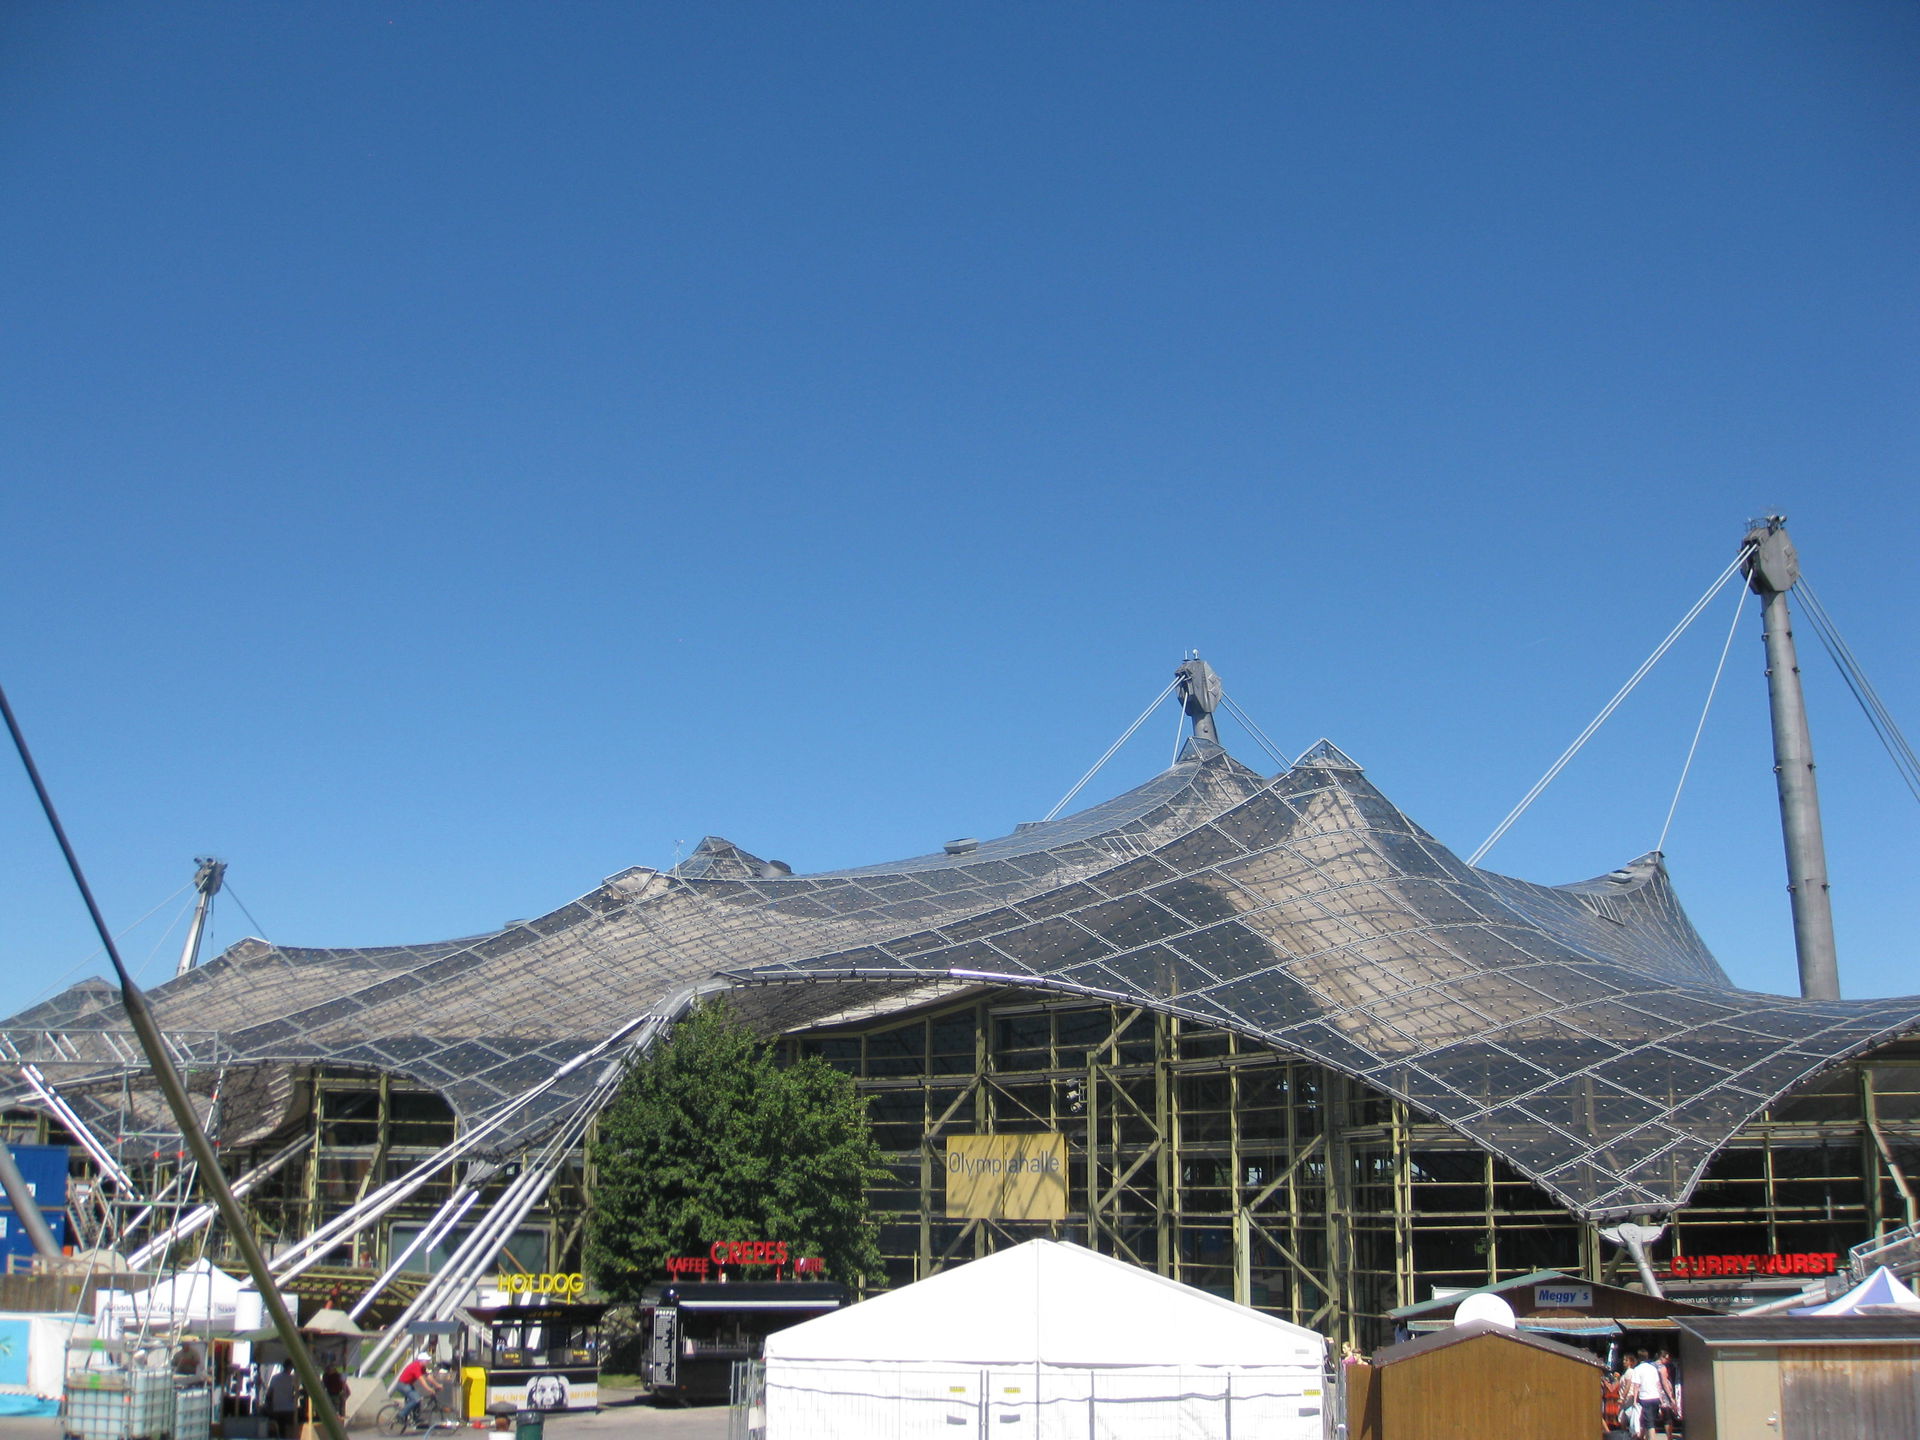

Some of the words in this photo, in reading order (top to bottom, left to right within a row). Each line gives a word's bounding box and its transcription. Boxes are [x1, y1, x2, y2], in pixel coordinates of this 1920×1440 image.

[949, 1151, 1060, 1176] Olympiahalle
[710, 1241, 788, 1264] CREPES
[666, 1257, 709, 1272] KAFFEE
[1670, 1253, 1838, 1275] CURRYWURST
[498, 1273, 536, 1293] HOT
[540, 1273, 584, 1293] DOG
